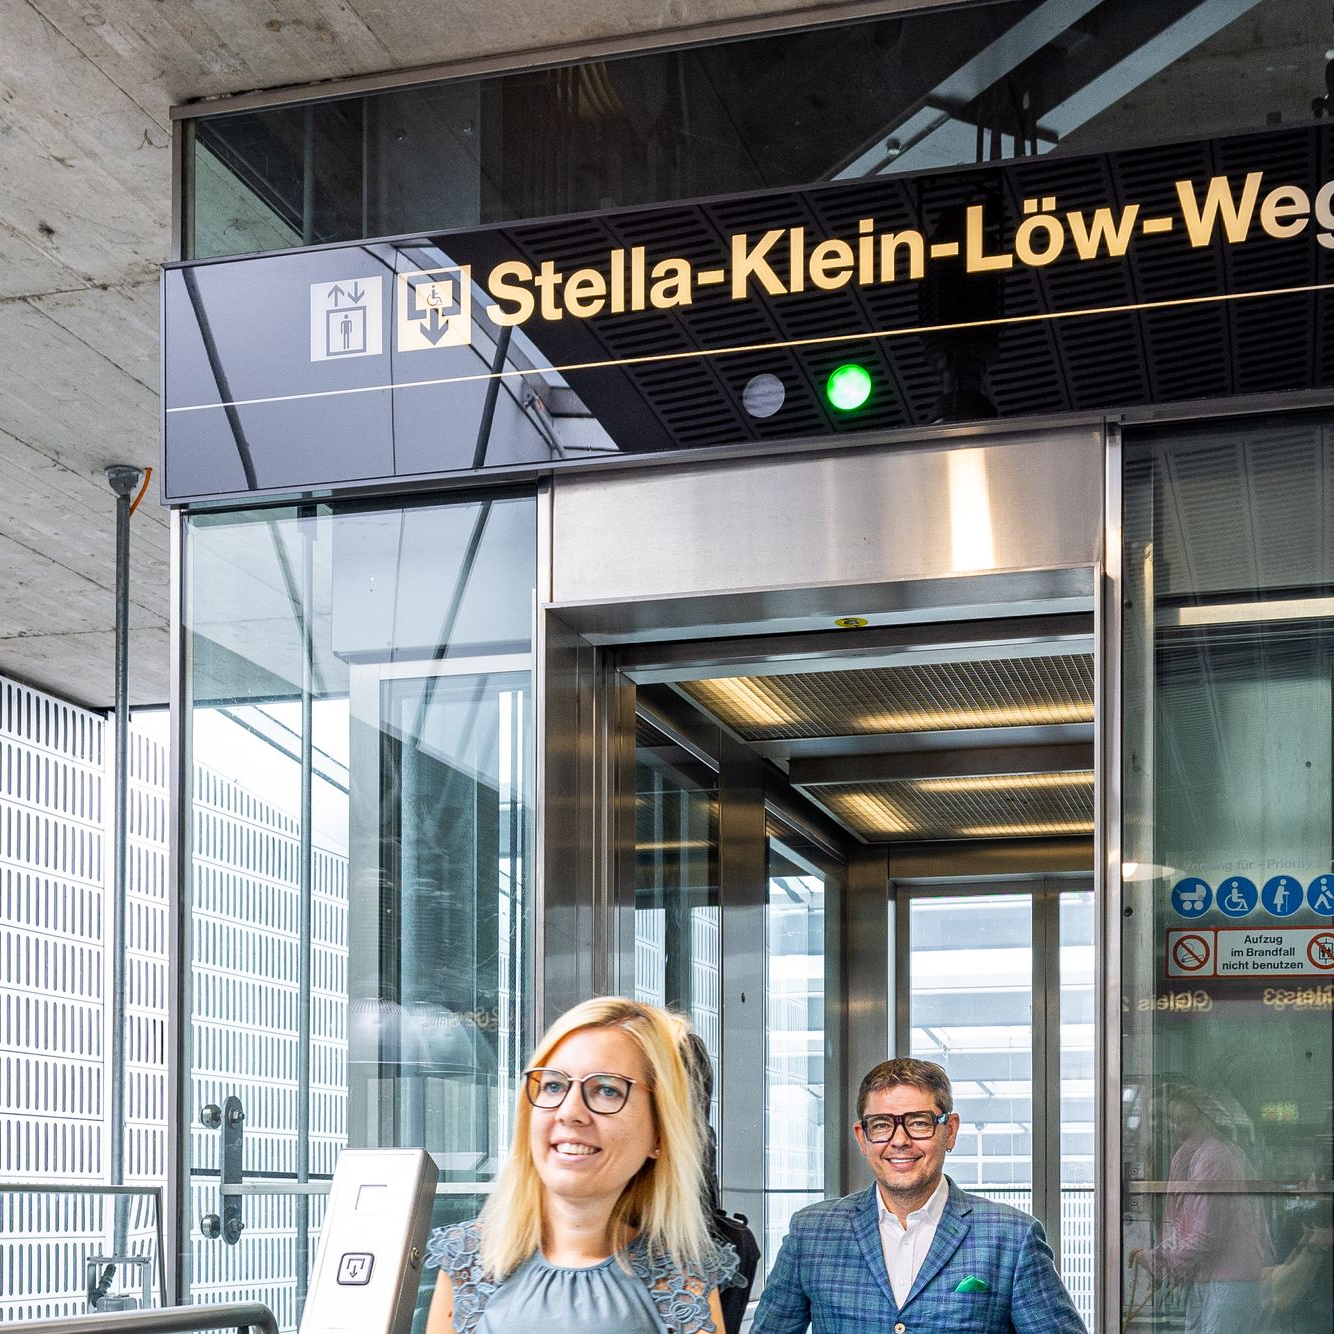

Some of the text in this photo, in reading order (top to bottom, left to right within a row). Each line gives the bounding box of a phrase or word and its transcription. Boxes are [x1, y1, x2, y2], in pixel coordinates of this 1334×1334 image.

[1183, 861, 1233, 872] Vorng
[1244, 934, 1283, 945] Aufzug
[1230, 947, 1295, 957] im Brandfall
[1222, 960, 1304, 970] nicht benutzen
